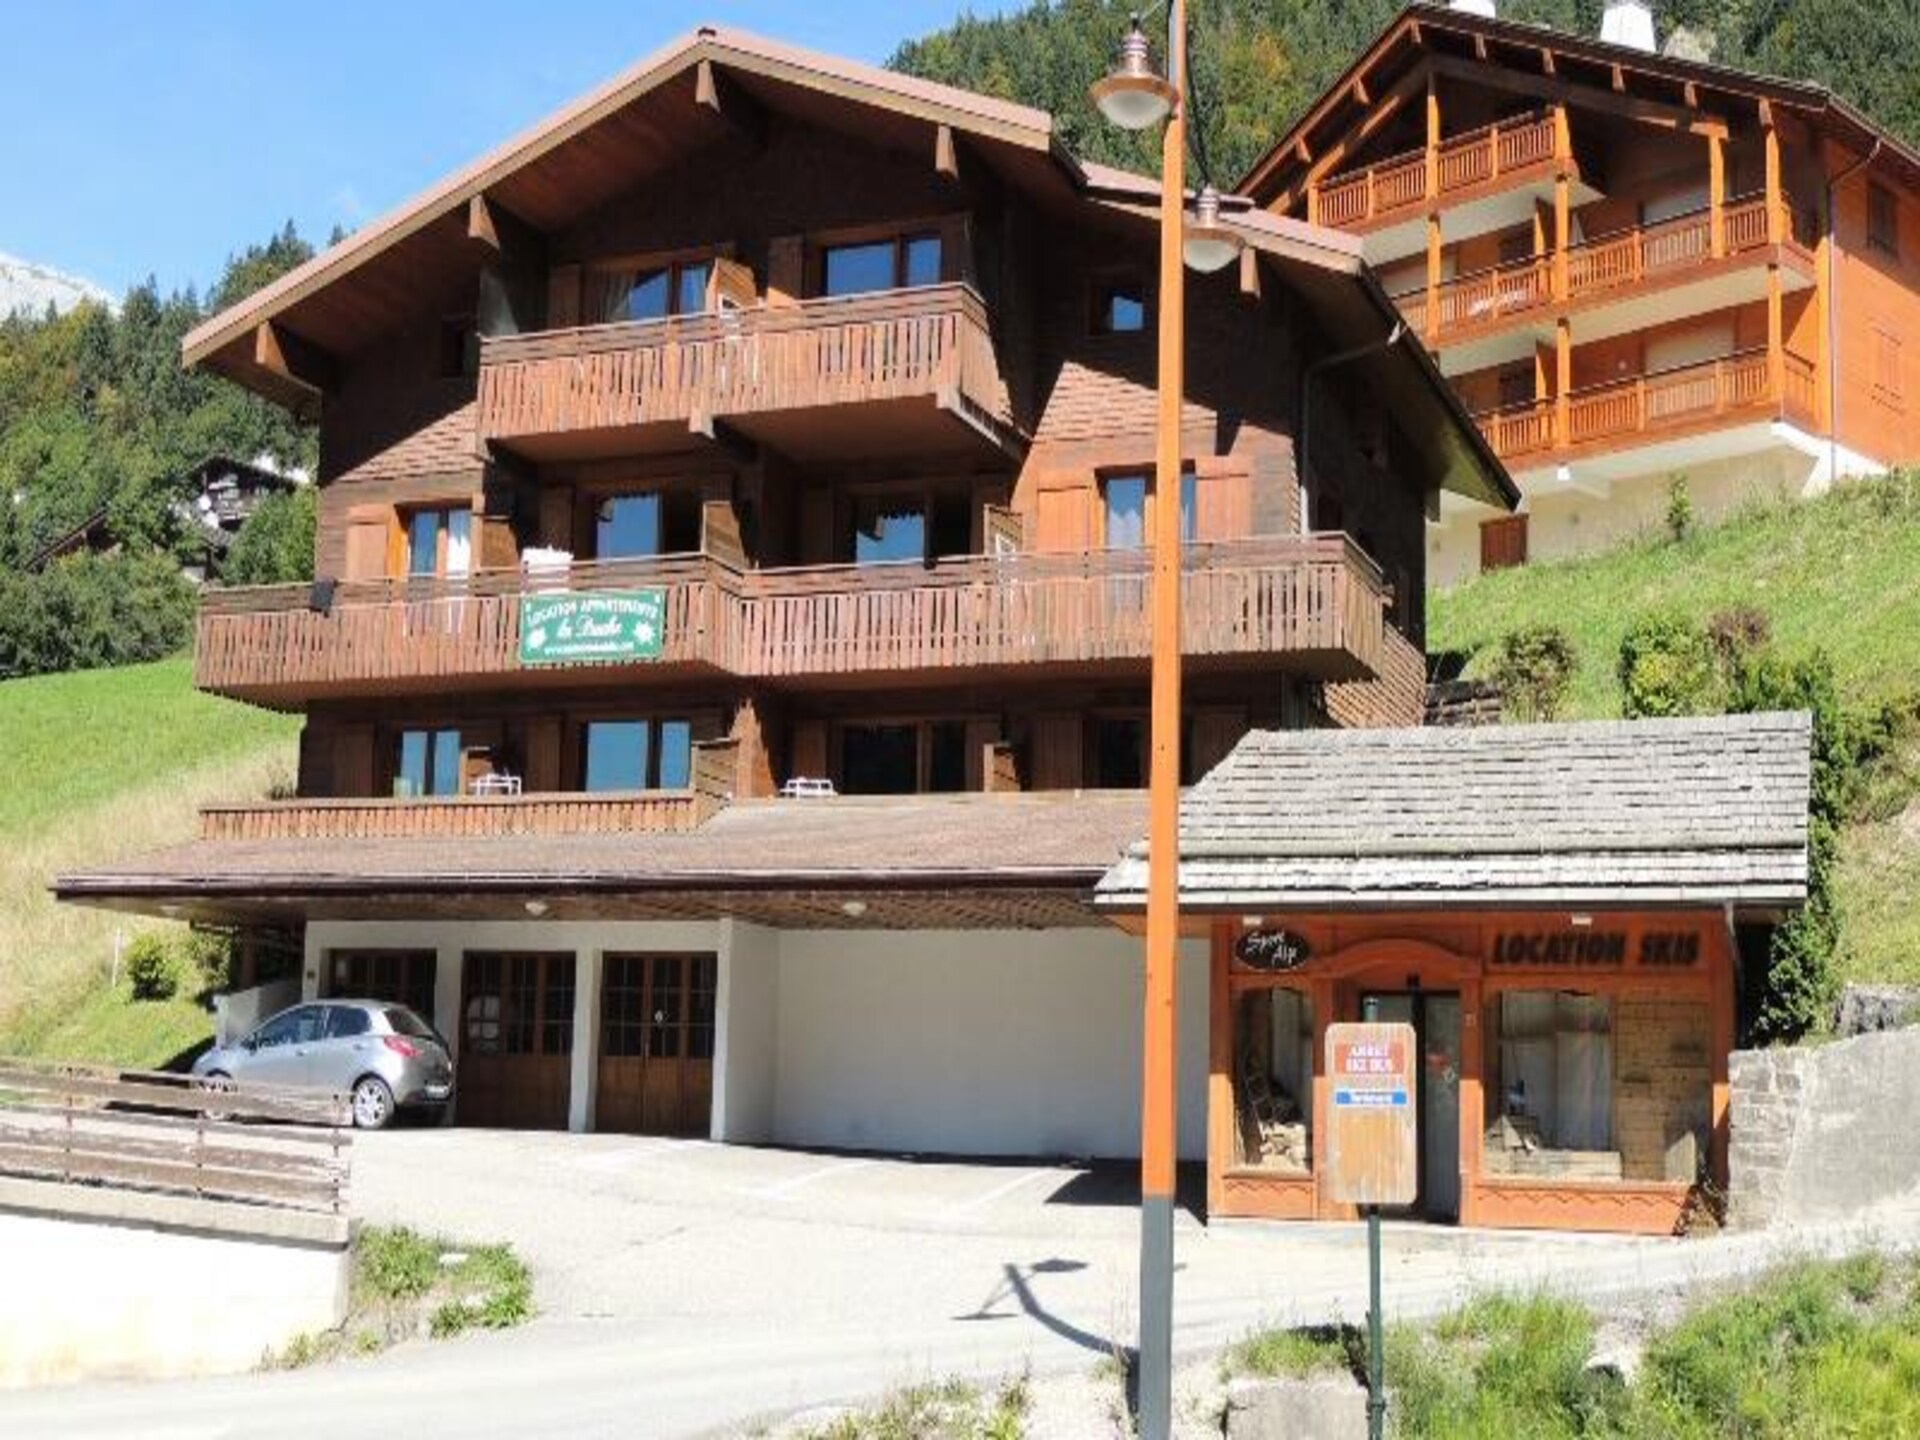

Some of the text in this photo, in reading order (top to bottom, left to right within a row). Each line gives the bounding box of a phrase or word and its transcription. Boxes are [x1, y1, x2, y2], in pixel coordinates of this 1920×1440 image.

[527, 601, 577, 625] LOCATION
[1493, 932, 1700, 964] LOCATION SKIS
